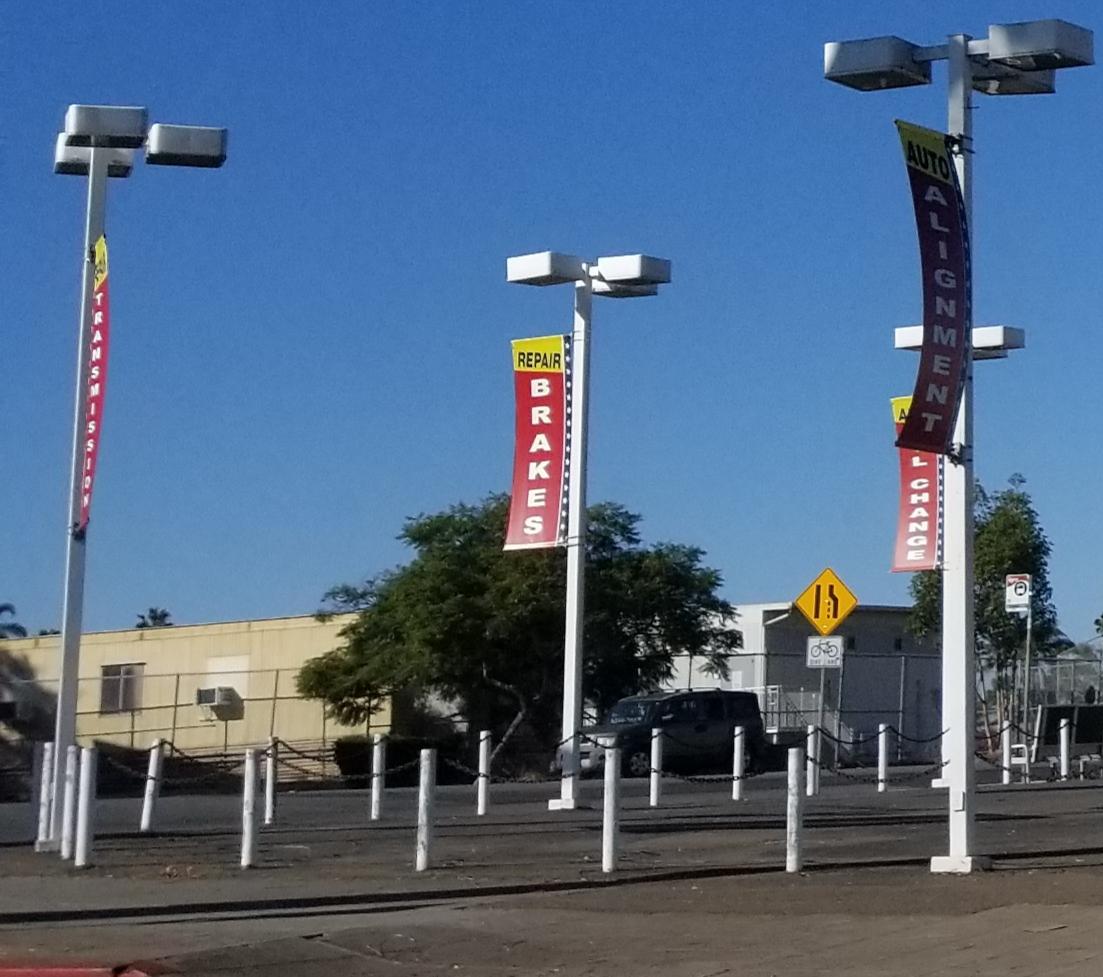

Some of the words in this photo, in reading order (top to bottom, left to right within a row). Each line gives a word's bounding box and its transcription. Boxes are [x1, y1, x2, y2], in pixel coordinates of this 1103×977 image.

[907, 140, 950, 180] AUTO
[517, 351, 562, 370] REPAIR
[921, 184, 957, 433] ALIGNMENT
[83, 291, 103, 509] TRANSMISSION
[523, 378, 552, 536] BRAKES
[906, 477, 930, 561] CHANGE
